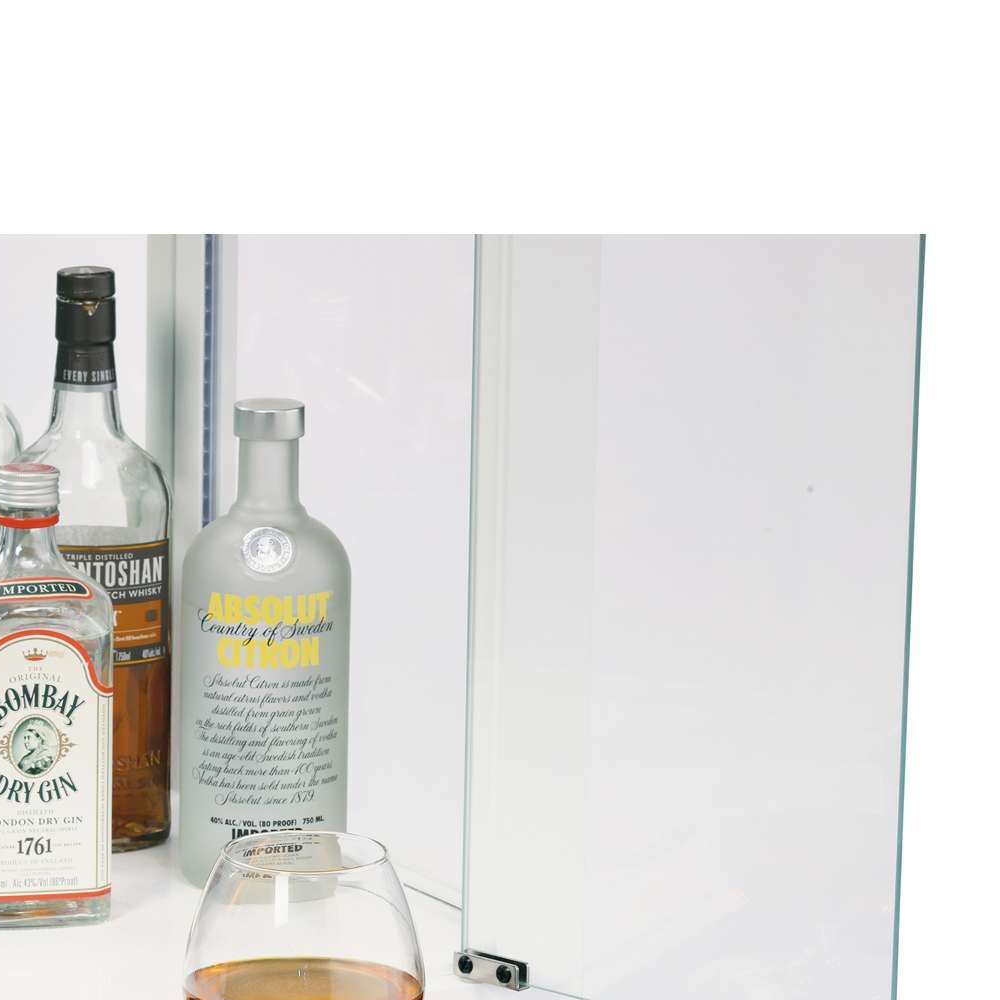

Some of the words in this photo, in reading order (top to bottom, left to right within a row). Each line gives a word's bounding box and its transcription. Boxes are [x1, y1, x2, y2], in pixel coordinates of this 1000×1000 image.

[63, 369, 88, 382] EVERY
[95, 552, 134, 560] DISTILLED
[128, 585, 162, 598] WHISKY
[207, 591, 335, 625] ABSOLUT
[197, 607, 258, 647] Country
[262, 621, 282, 647] of
[280, 616, 335, 640] Sweden
[215, 636, 321, 670] CITRON
[8, 672, 64, 684] ORIGINAL
[37, 772, 78, 804] GIN
[38, 817, 59, 825] DRY
[63, 815, 83, 824] GIN
[210, 816, 223, 825] 40%
[259, 819, 271, 828] (80
[272, 818, 297, 827] PROOF)
[302, 816, 314, 825] 750
[17, 836, 53, 856] 1761
